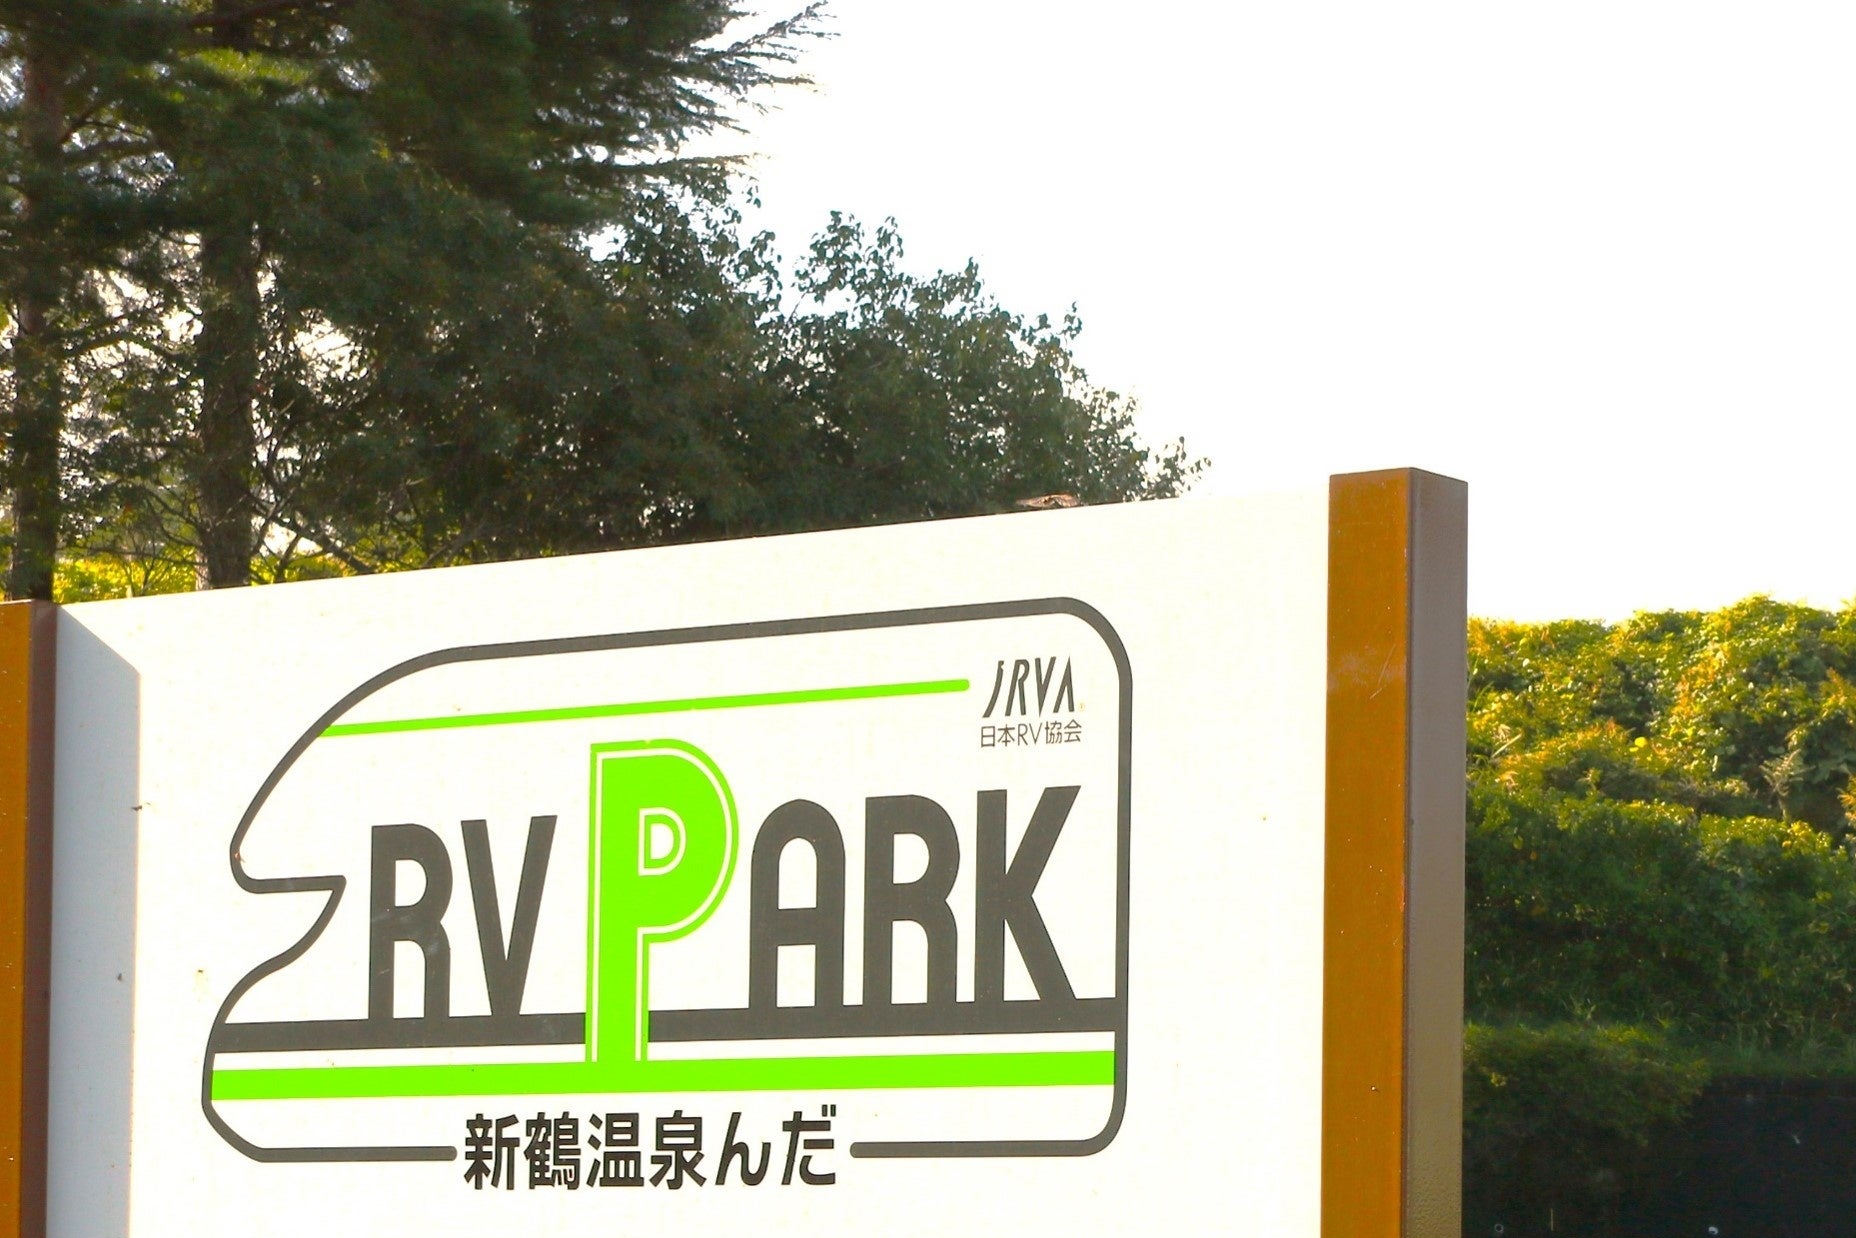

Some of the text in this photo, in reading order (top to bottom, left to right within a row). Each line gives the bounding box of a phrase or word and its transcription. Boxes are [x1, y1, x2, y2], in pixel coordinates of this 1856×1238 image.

[980, 719, 1083, 748] 日本RV協会
[368, 738, 1082, 1062] RV PARK
[463, 1104, 837, 1190] 新鶴温泉んだ
